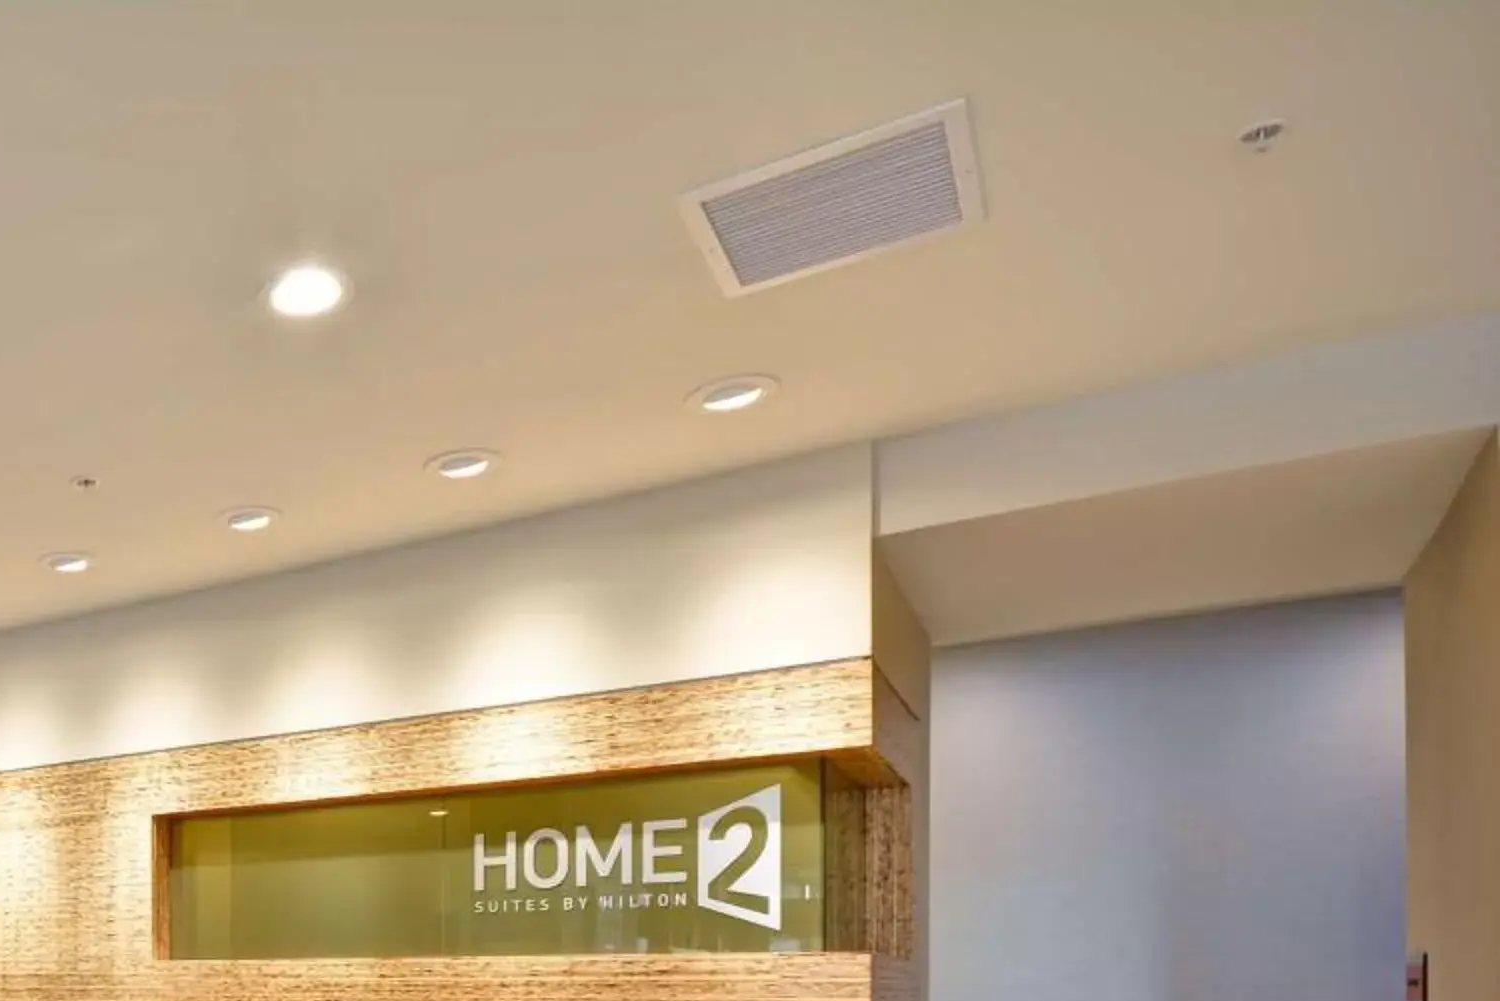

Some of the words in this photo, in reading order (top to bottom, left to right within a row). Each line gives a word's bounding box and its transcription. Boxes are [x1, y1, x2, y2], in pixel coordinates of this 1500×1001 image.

[473, 898, 550, 913] SUITES
[562, 896, 589, 912] BY
[599, 892, 688, 910] HILTON
